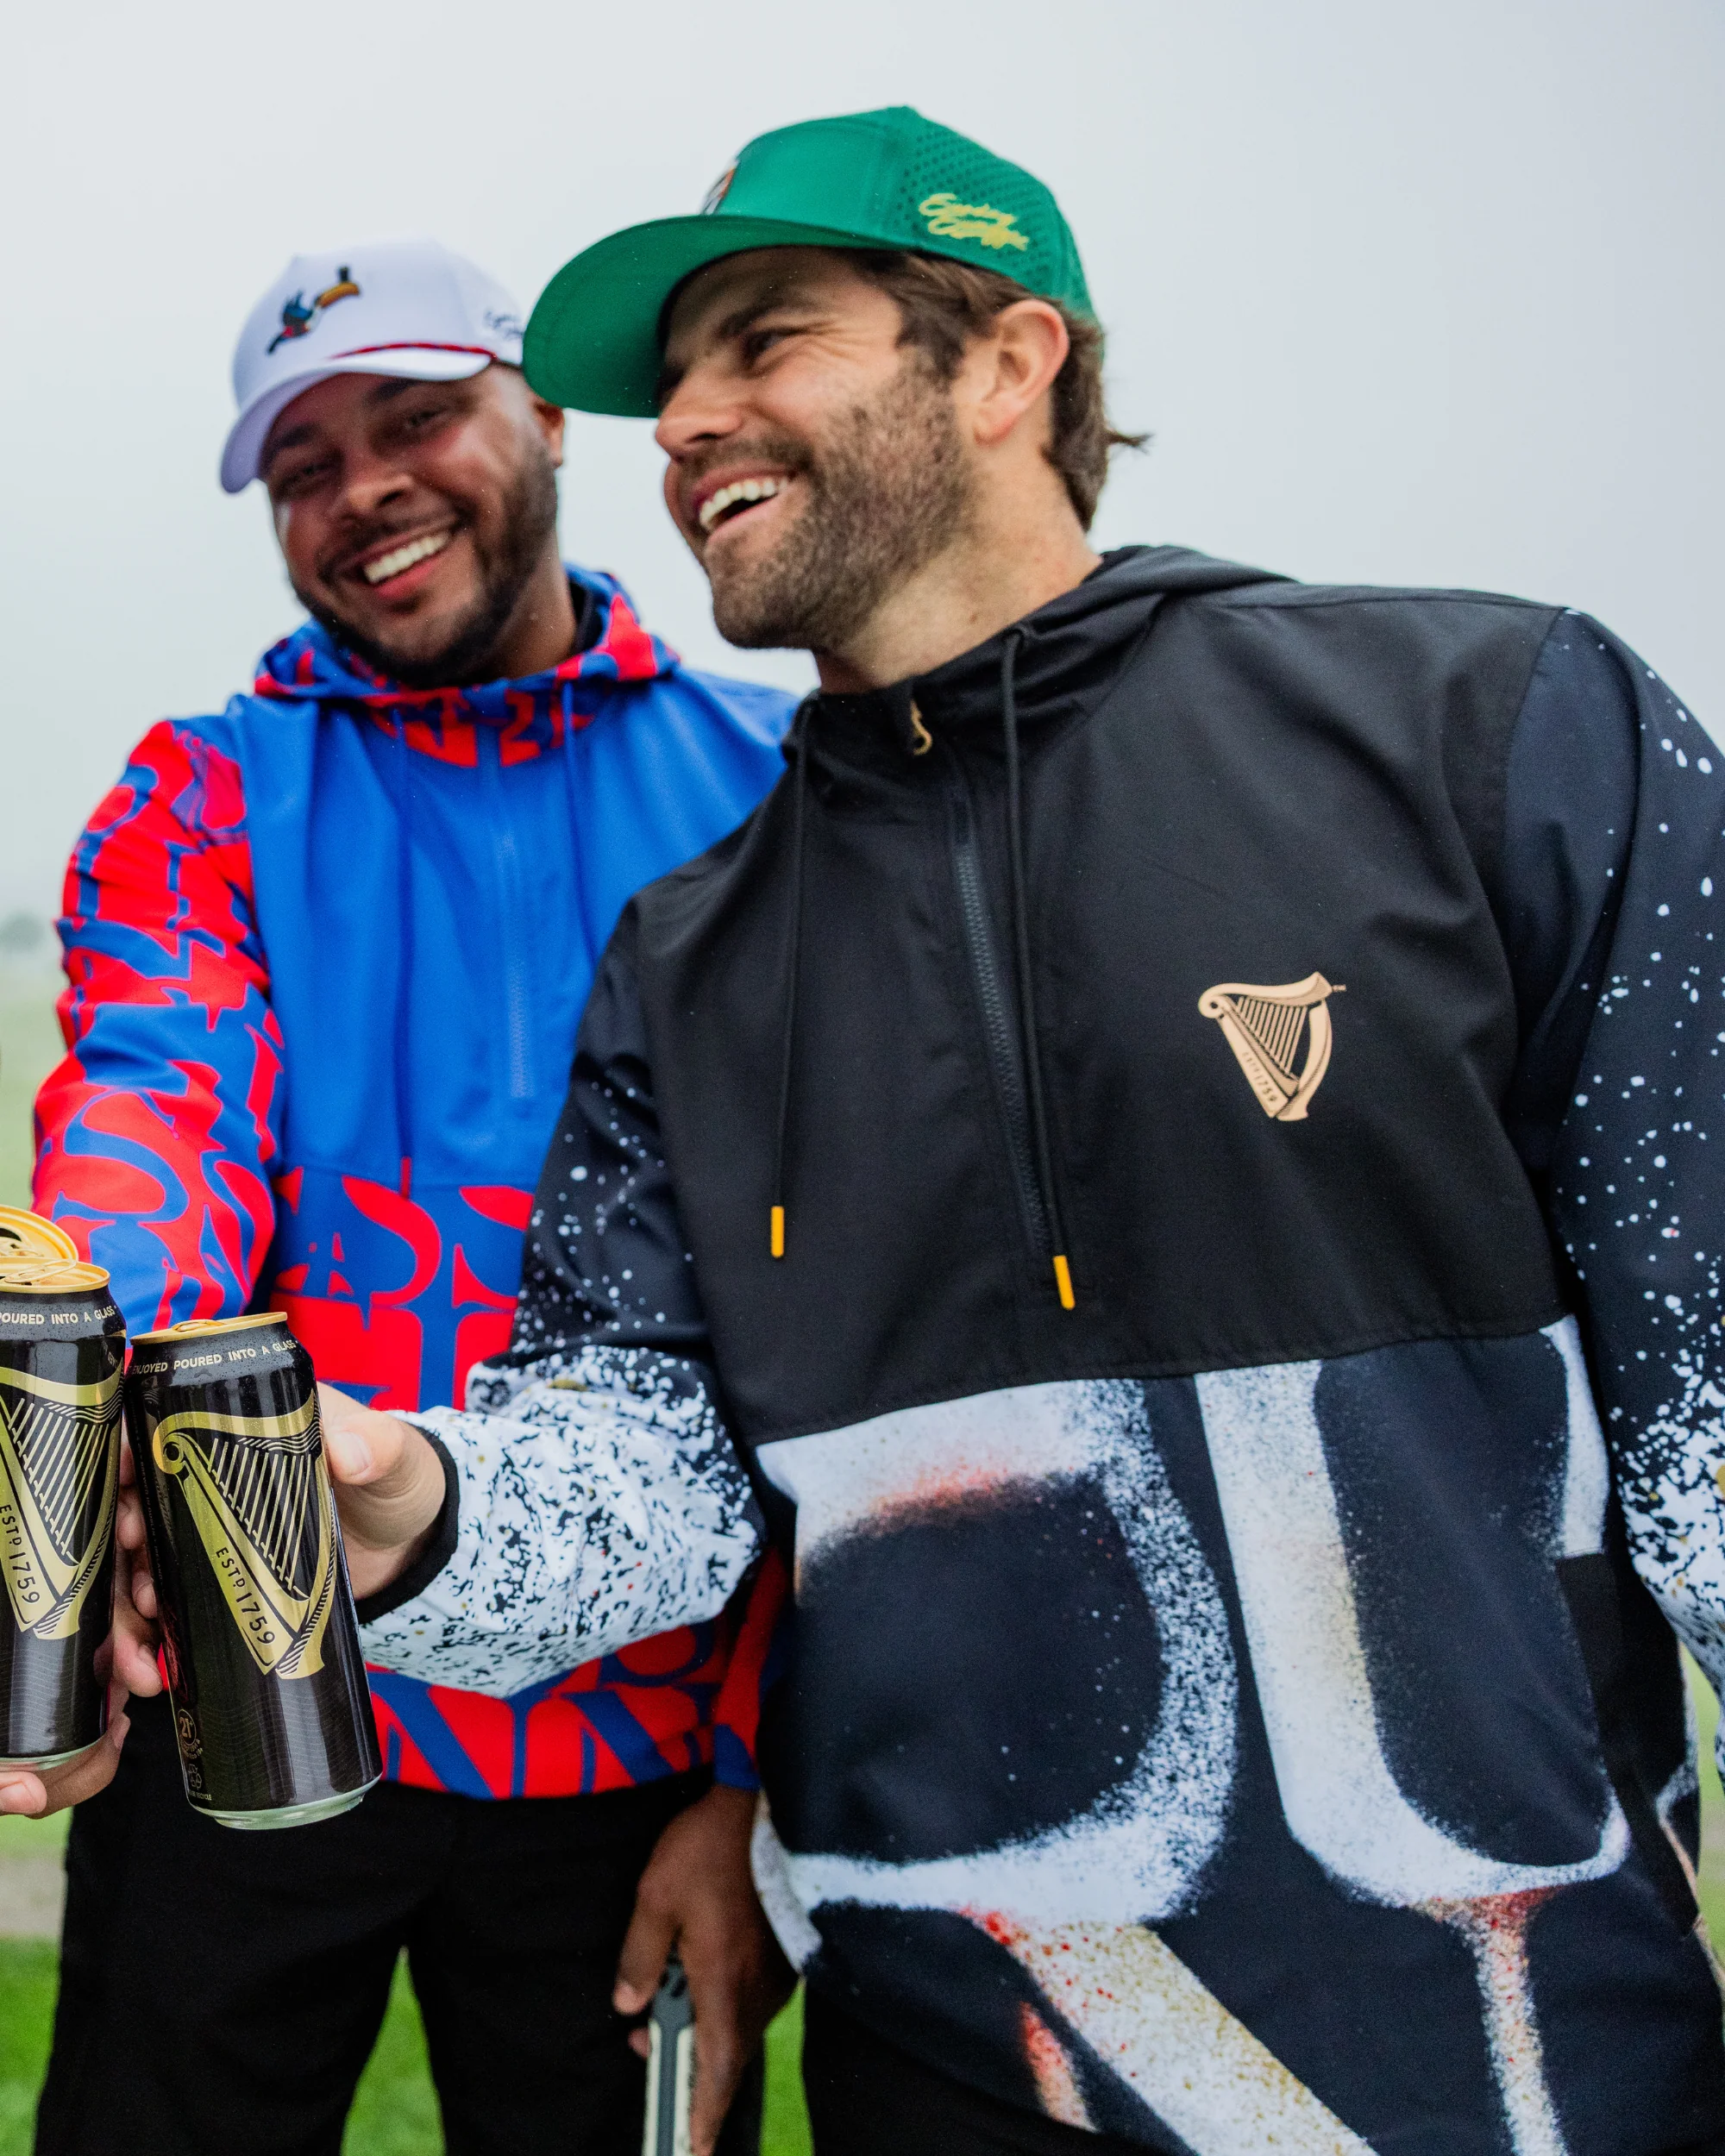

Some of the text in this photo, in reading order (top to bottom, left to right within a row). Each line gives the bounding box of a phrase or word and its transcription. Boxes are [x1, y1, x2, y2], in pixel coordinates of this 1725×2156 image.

[0, 1305, 116, 1325] OURED INTO A GLASS
[132, 1361, 168, 1376] ENJOYED
[173, 1353, 223, 1370] POURED
[228, 1347, 257, 1362] INTO
[261, 1344, 270, 1356] A
[272, 1339, 297, 1352] GLASS
[8, 1551, 41, 1604] 1759
[235, 1591, 276, 1645] 1759
